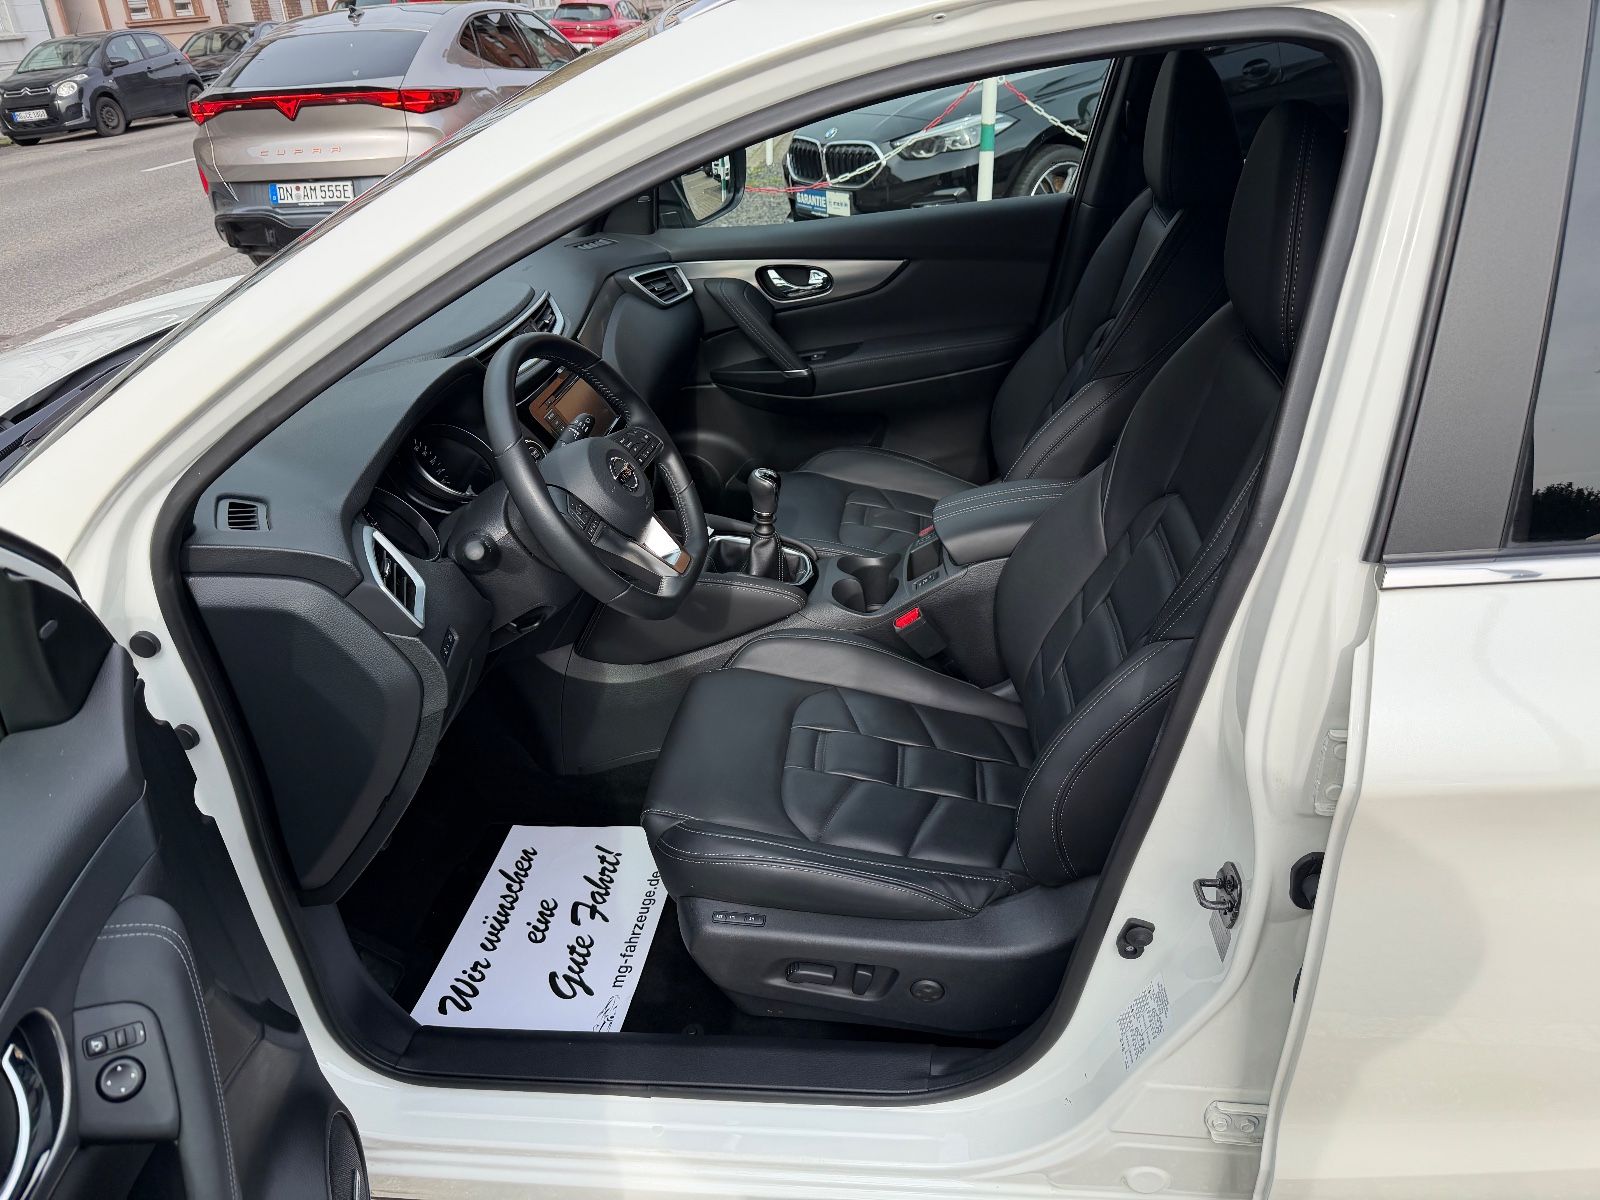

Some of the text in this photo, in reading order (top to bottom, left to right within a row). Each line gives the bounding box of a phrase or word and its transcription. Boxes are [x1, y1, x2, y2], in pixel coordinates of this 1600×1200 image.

[260, 146, 341, 157] CUPRA
[278, 184, 351, 201] DN AM 555E
[797, 192, 827, 208] GARANTIE
[437, 846, 539, 1016] Wir wünschen
[526, 897, 559, 944] eine
[548, 844, 623, 1000] Gute Fahrt!
[611, 870, 661, 988] mg-fahrzeuge.de
